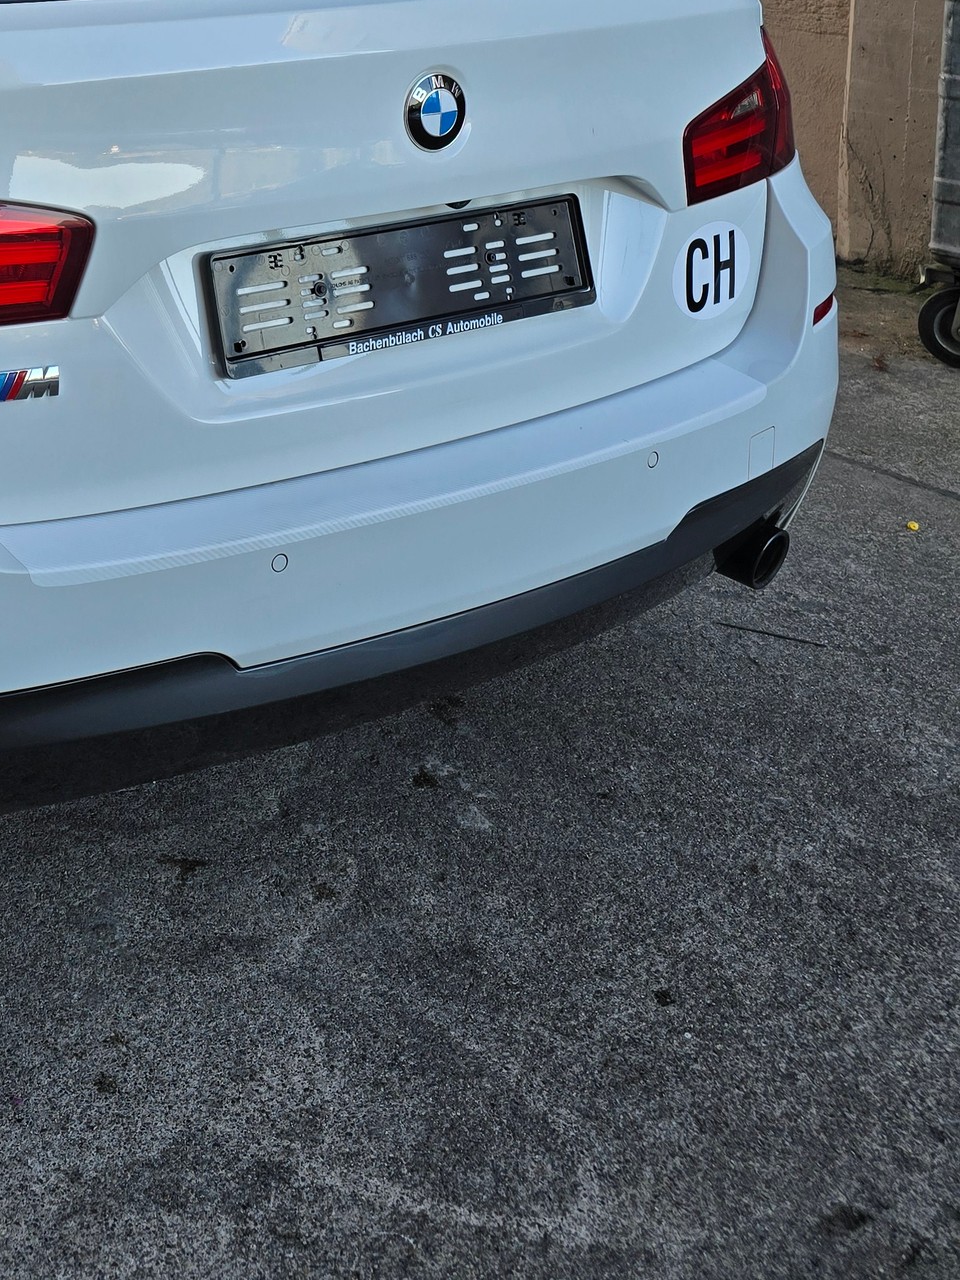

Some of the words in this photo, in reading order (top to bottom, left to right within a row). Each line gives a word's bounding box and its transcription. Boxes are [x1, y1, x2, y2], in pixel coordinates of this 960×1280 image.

[412, 75, 462, 103] BMW
[685, 229, 736, 313] CH
[349, 329, 425, 355] Bachenbülach
[428, 323, 443, 338] CS
[446, 312, 504, 335] Automobile
